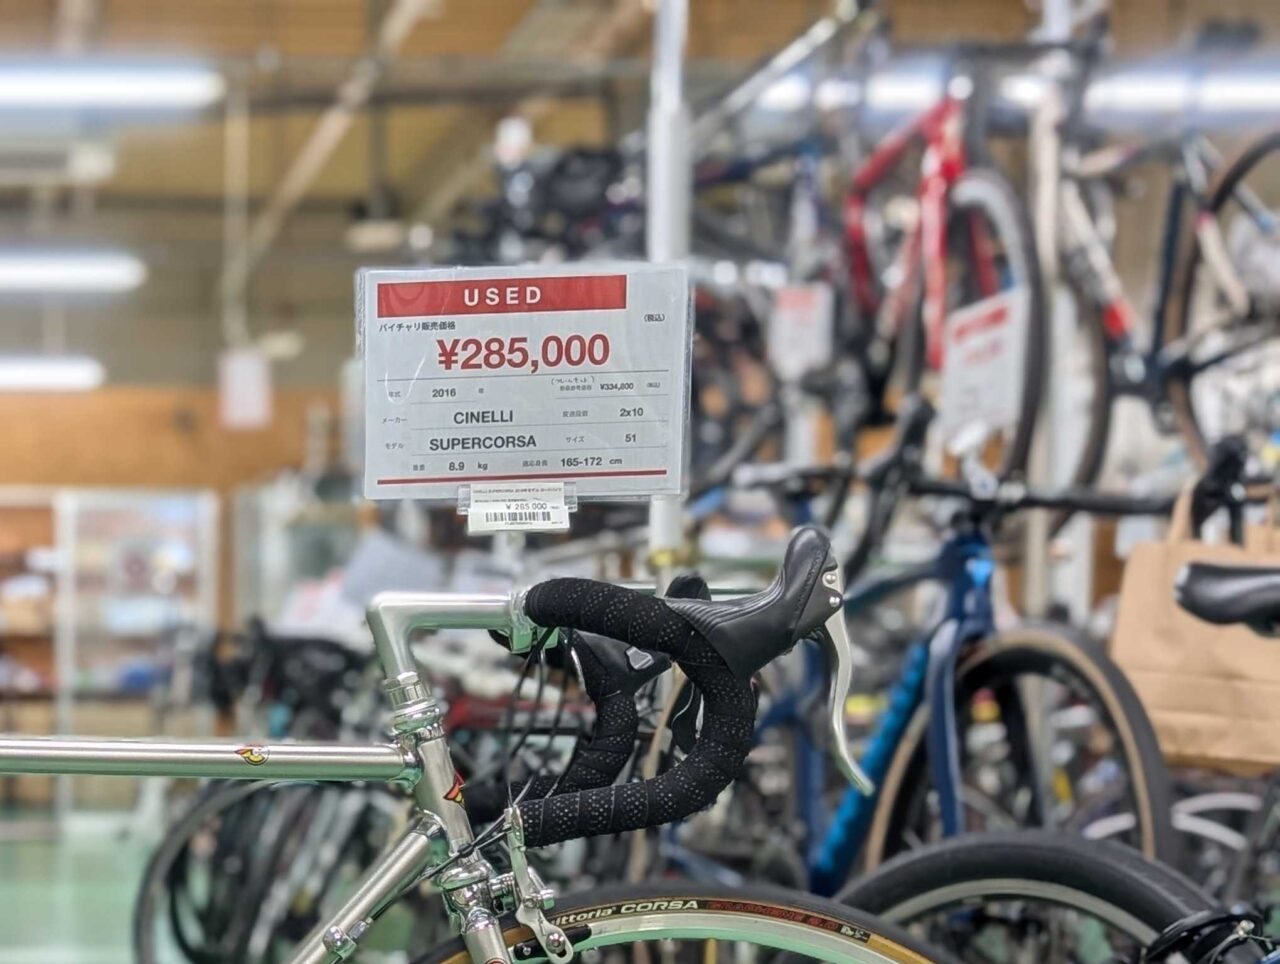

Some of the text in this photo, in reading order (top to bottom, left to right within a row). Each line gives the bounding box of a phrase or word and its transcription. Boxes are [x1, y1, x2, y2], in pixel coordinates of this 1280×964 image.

[464, 286, 541, 307] USED
[379, 321, 456, 333] バイチャリ販売価格
[436, 333, 610, 374] ¥285,000
[432, 388, 456, 398] 2016
[453, 410, 513, 424] CINELLI
[620, 407, 644, 417] 2x10
[382, 416, 407, 424] メーカー
[429, 435, 537, 451] SUPERCORSA
[625, 433, 637, 443] 51
[385, 442, 404, 450] モデル
[448, 461, 488, 471] 8.9 kg
[560, 457, 602, 467] 165-172
[620, 900, 699, 912] CORSA
